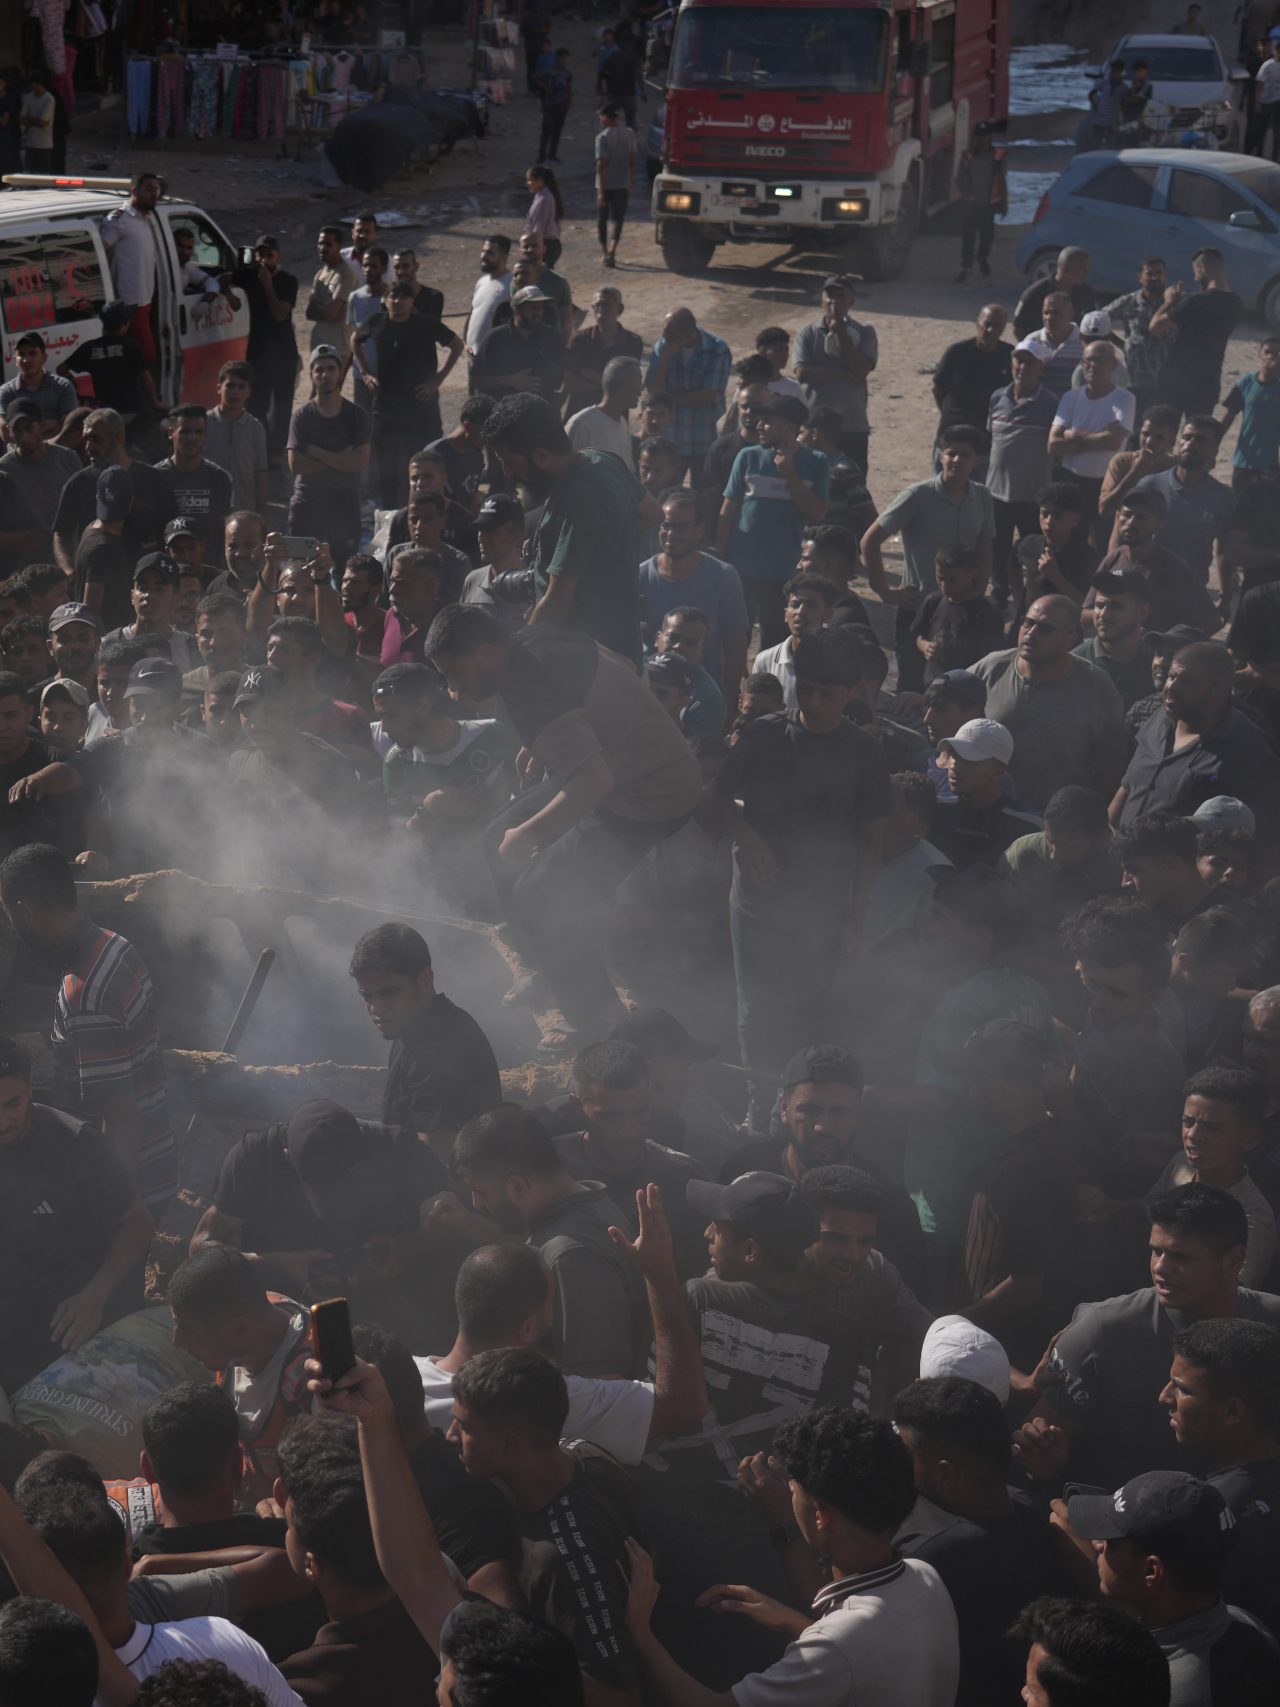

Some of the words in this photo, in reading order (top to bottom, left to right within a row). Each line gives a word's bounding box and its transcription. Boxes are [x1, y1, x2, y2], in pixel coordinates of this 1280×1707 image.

[745, 145, 787, 157] IVECO
[565, 1560, 581, 1581] ICON
[576, 1587, 590, 1608] ICON
[585, 1613, 599, 1635] ICON
[582, 1554, 597, 1575] ICON
[593, 1581, 607, 1602] ICON
